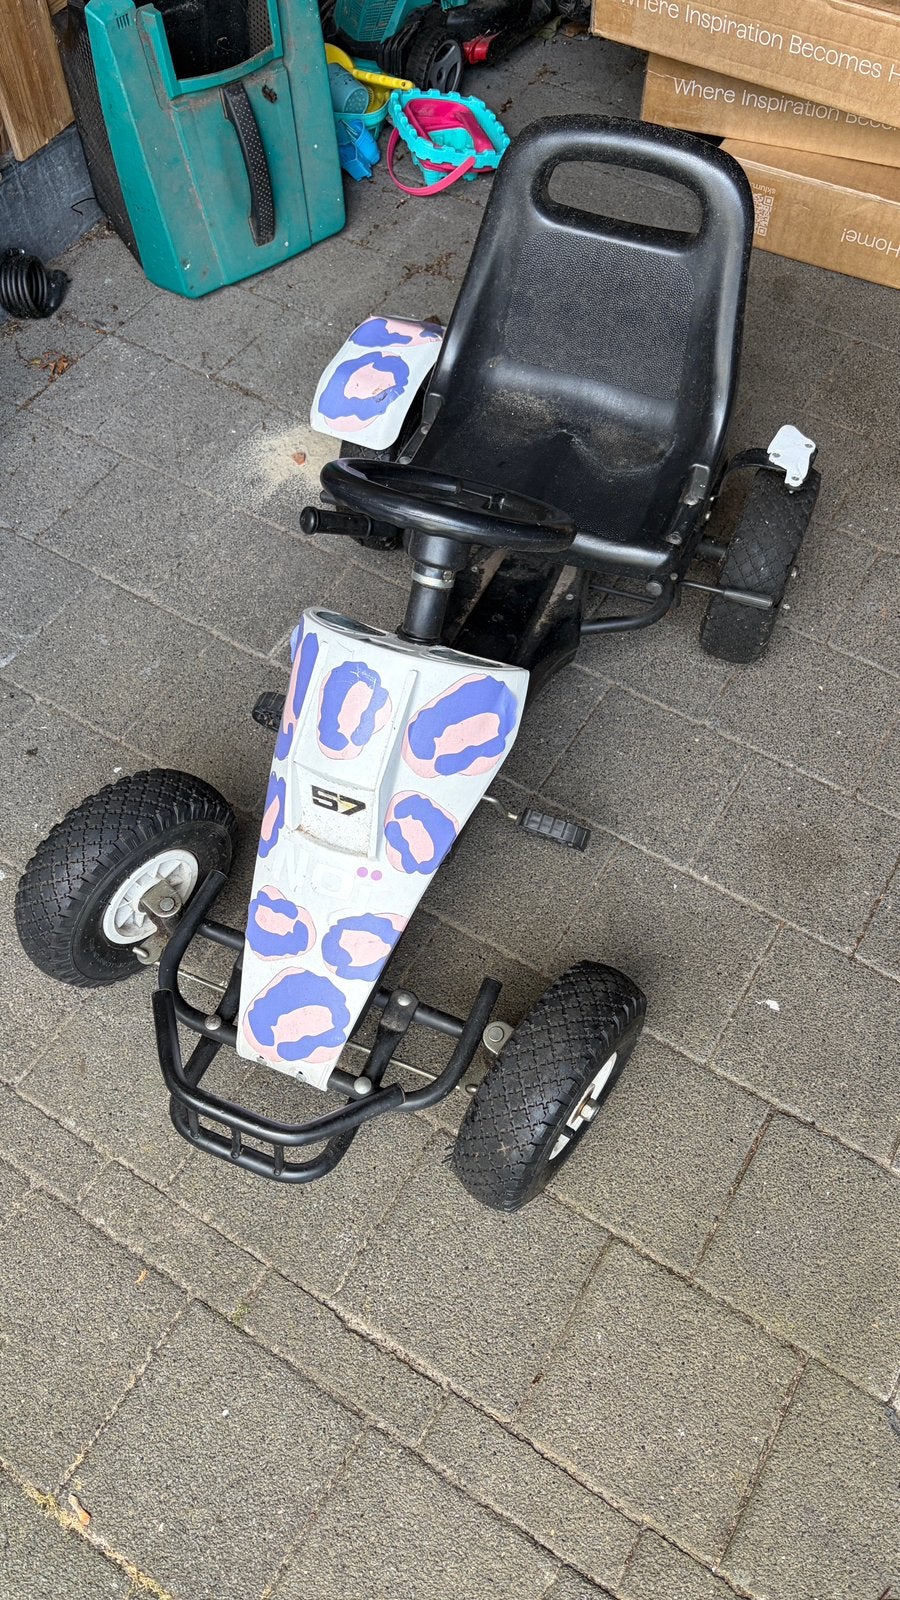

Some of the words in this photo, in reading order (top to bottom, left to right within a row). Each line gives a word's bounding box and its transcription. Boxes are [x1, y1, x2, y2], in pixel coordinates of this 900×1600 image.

[685, 5, 783, 49] Inspiration
[789, 35, 882, 79] Becomes
[673, 77, 736, 103] Where
[741, 89, 840, 121] Inspiration
[841, 228, 900, 258] Home!
